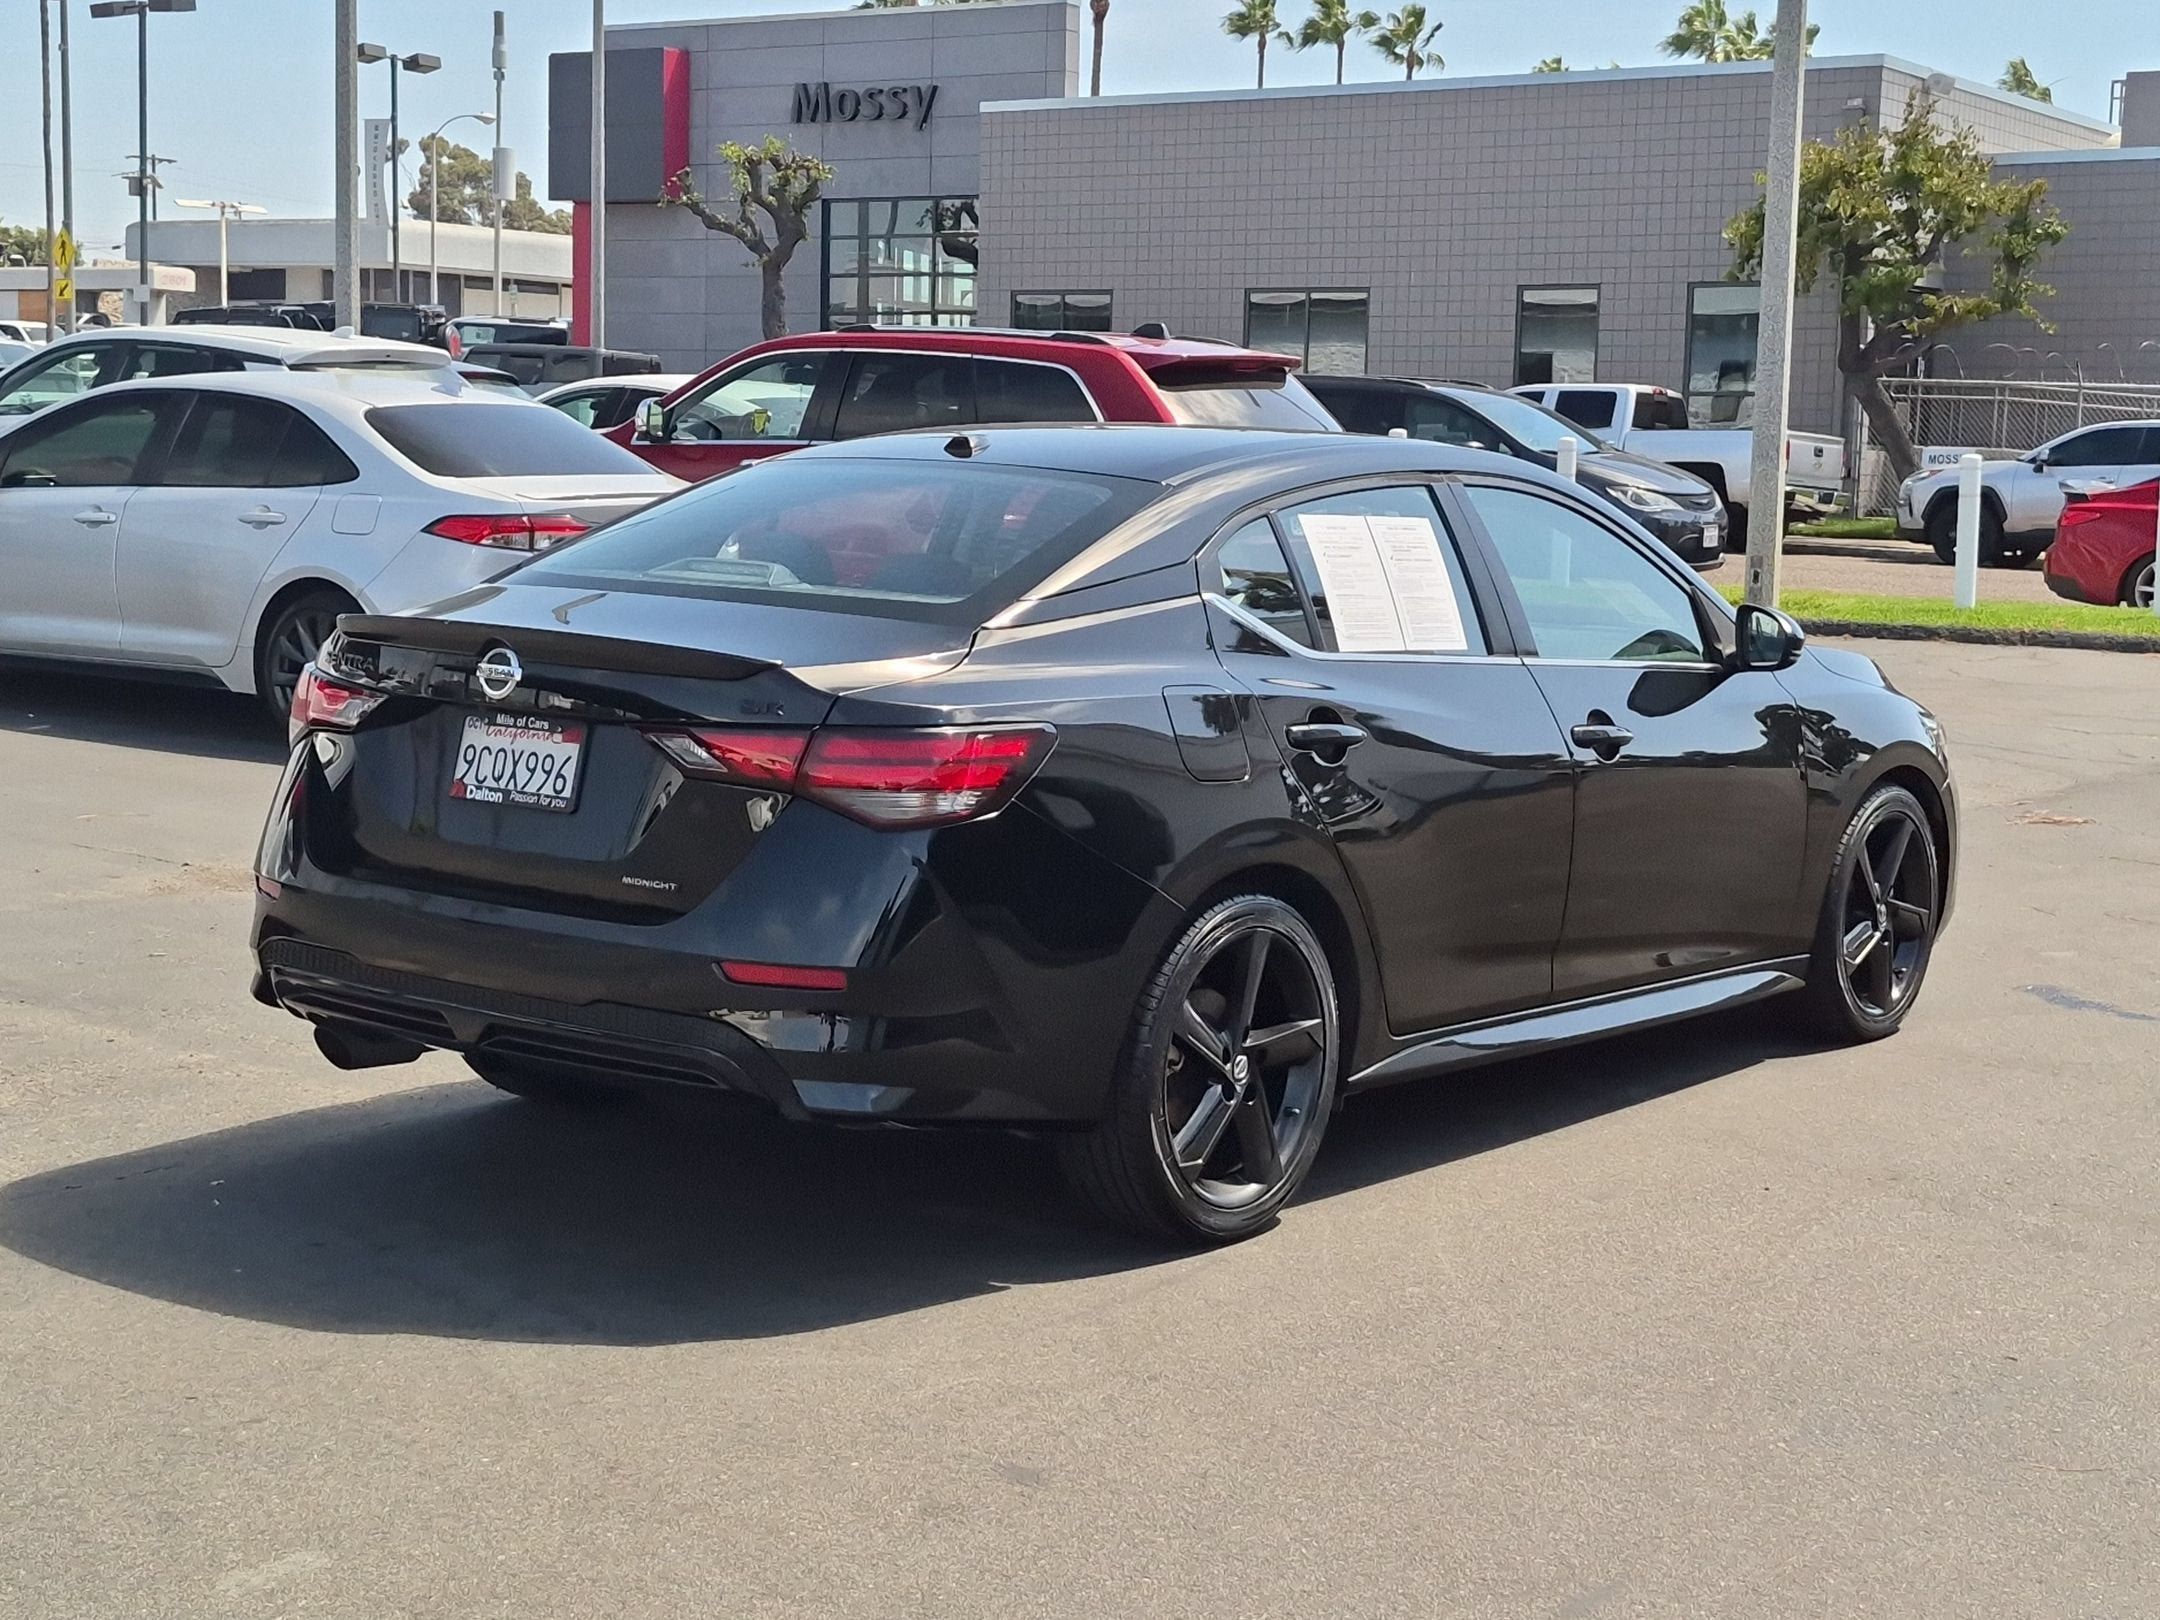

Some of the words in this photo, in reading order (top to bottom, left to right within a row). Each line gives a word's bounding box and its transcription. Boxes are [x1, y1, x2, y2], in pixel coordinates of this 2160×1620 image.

[791, 82, 940, 131] Mossy
[1928, 454, 1962, 465] MOSS
[496, 713, 515, 725] Mile
[516, 716, 526, 727] of
[527, 717, 549, 730] Cars
[459, 743, 573, 796] 9CQX996
[466, 786, 503, 803] Dalton
[509, 791, 538, 803] Passion
[538, 794, 552, 806] for
[551, 798, 567, 809] you
[621, 876, 678, 891] MIDNIGHT
